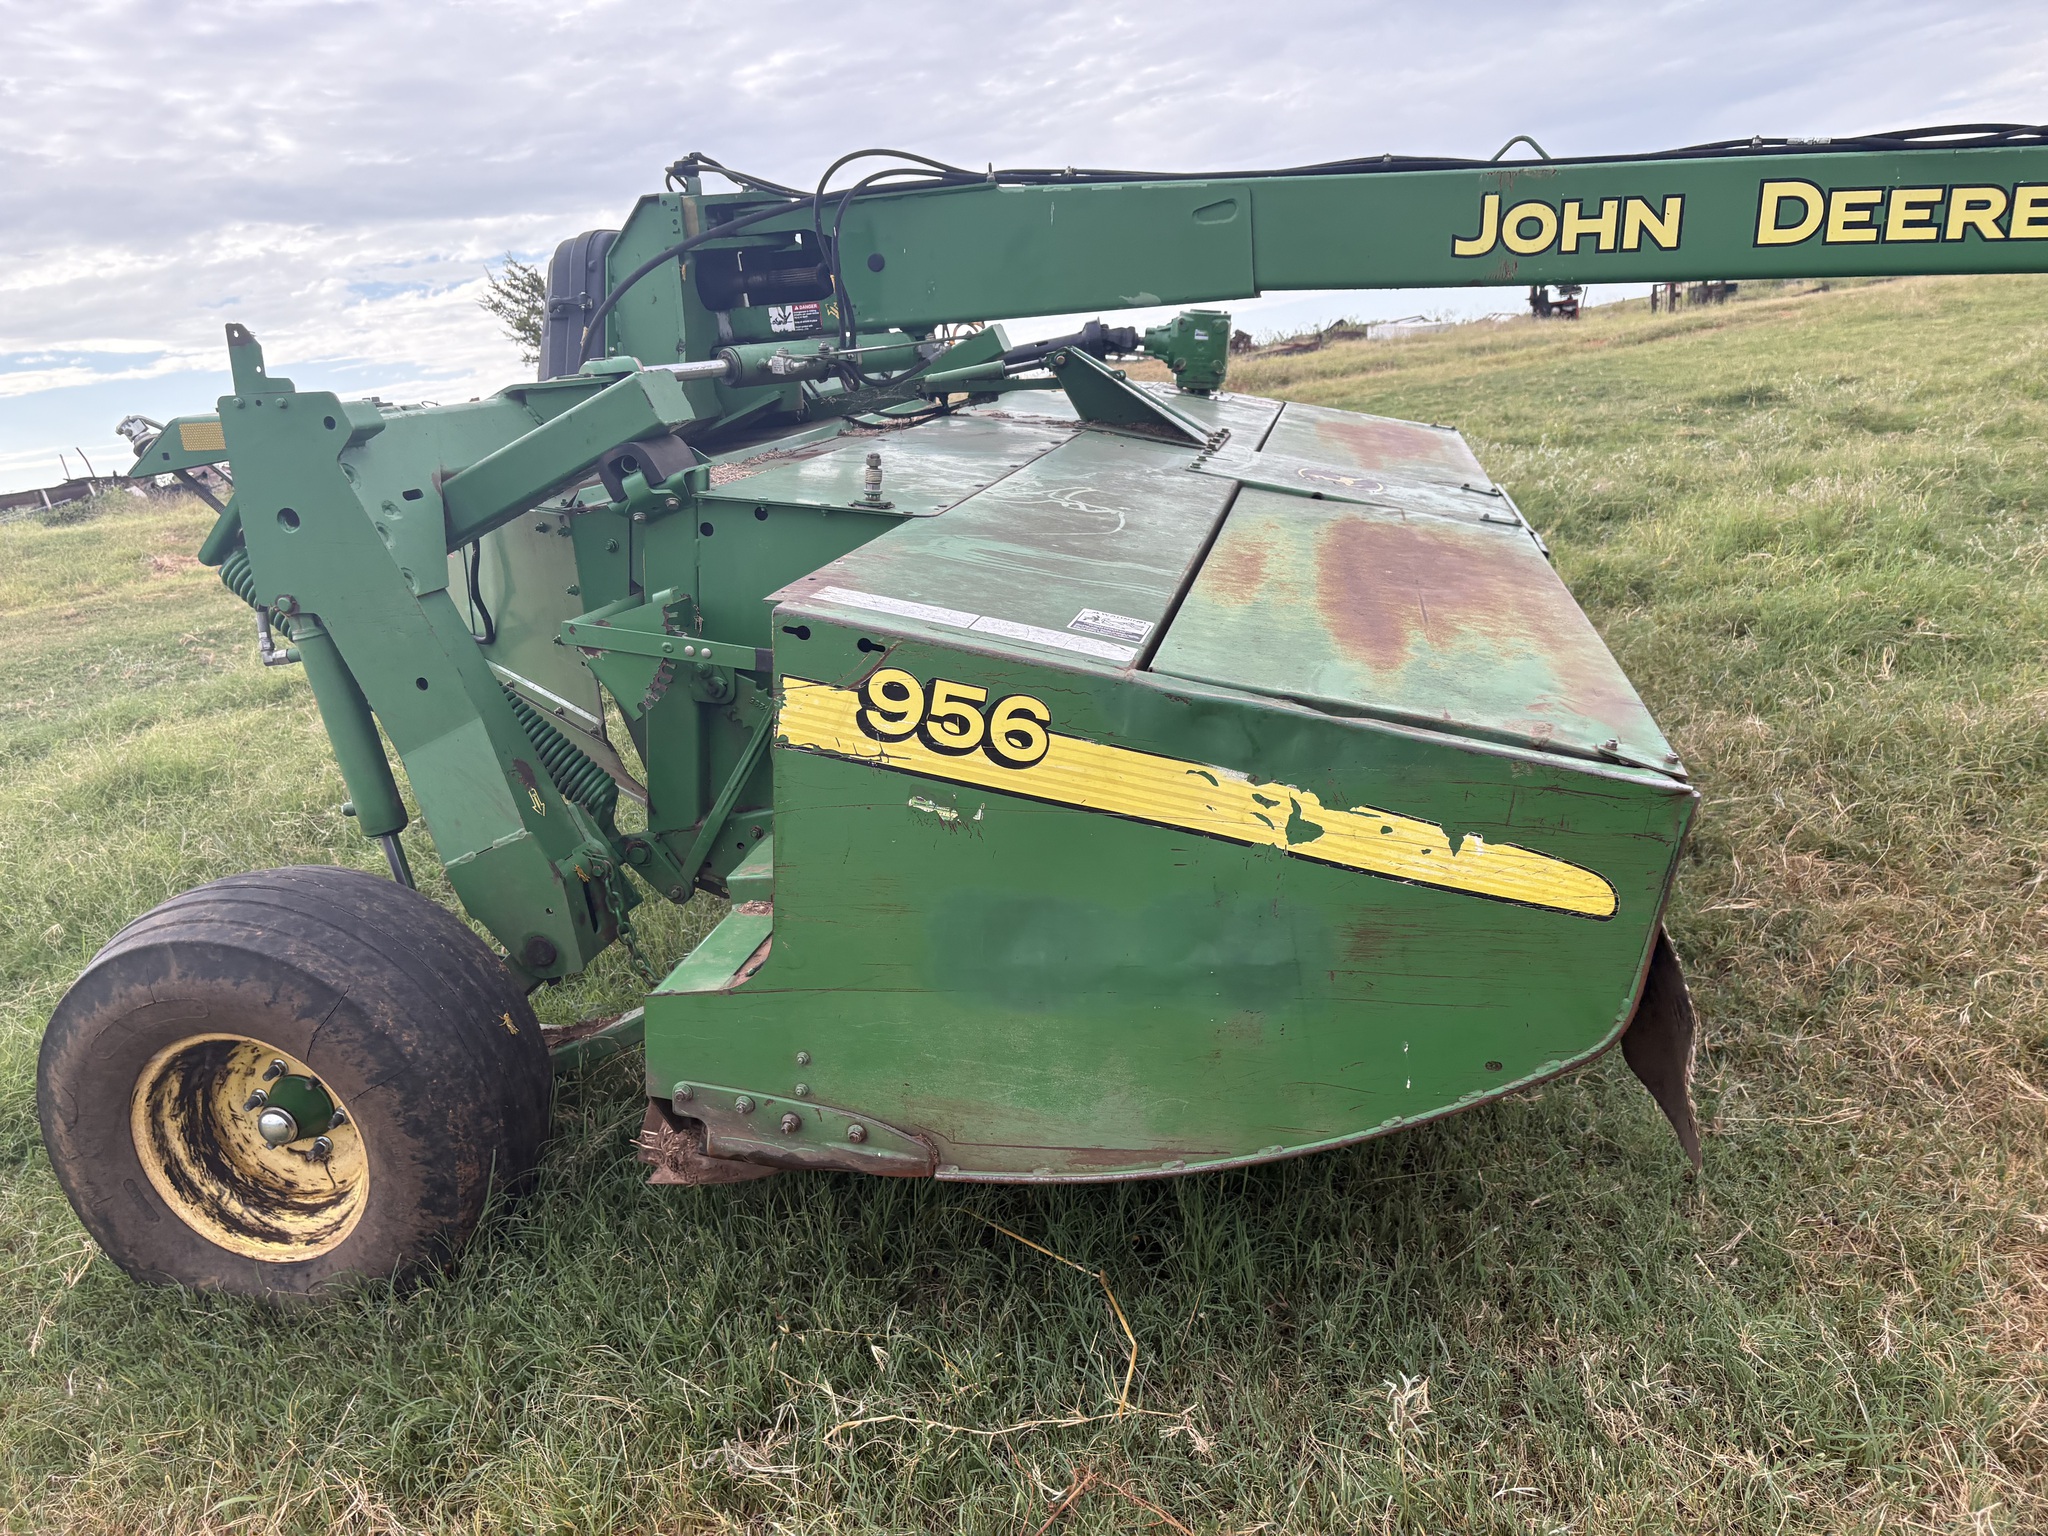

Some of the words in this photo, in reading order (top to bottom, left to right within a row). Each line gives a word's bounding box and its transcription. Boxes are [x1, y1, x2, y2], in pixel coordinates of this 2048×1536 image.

[1451, 192, 1685, 258] JOHN
[1753, 177, 2048, 248] DEERE
[856, 666, 1052, 770] 956
